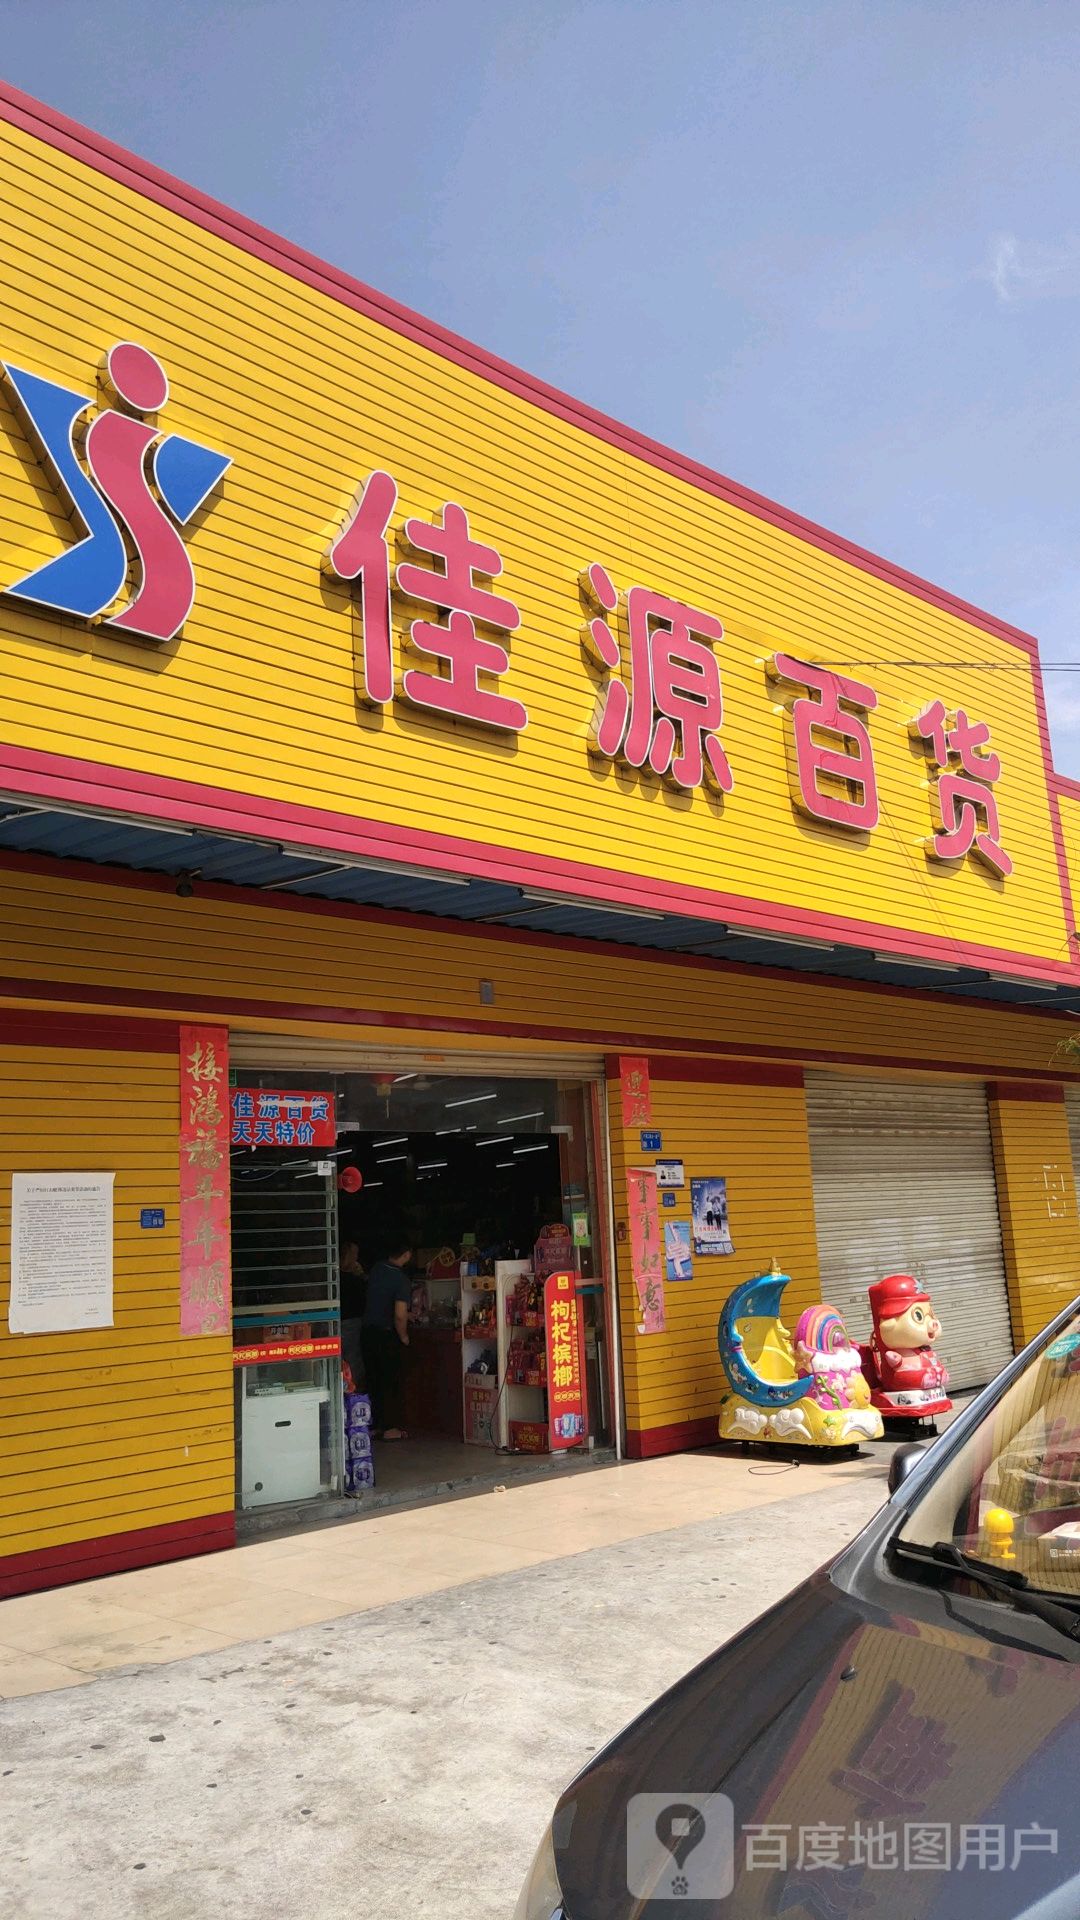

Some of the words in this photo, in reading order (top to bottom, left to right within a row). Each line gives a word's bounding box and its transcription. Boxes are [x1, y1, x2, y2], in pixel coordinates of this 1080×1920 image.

[329, 471, 1013, 878] 佳源百货
[232, 1092, 329, 1121] 佳源百货
[232, 1121, 315, 1145] 天天特价
[550, 1299, 572, 1388] 枸杞槟榔
